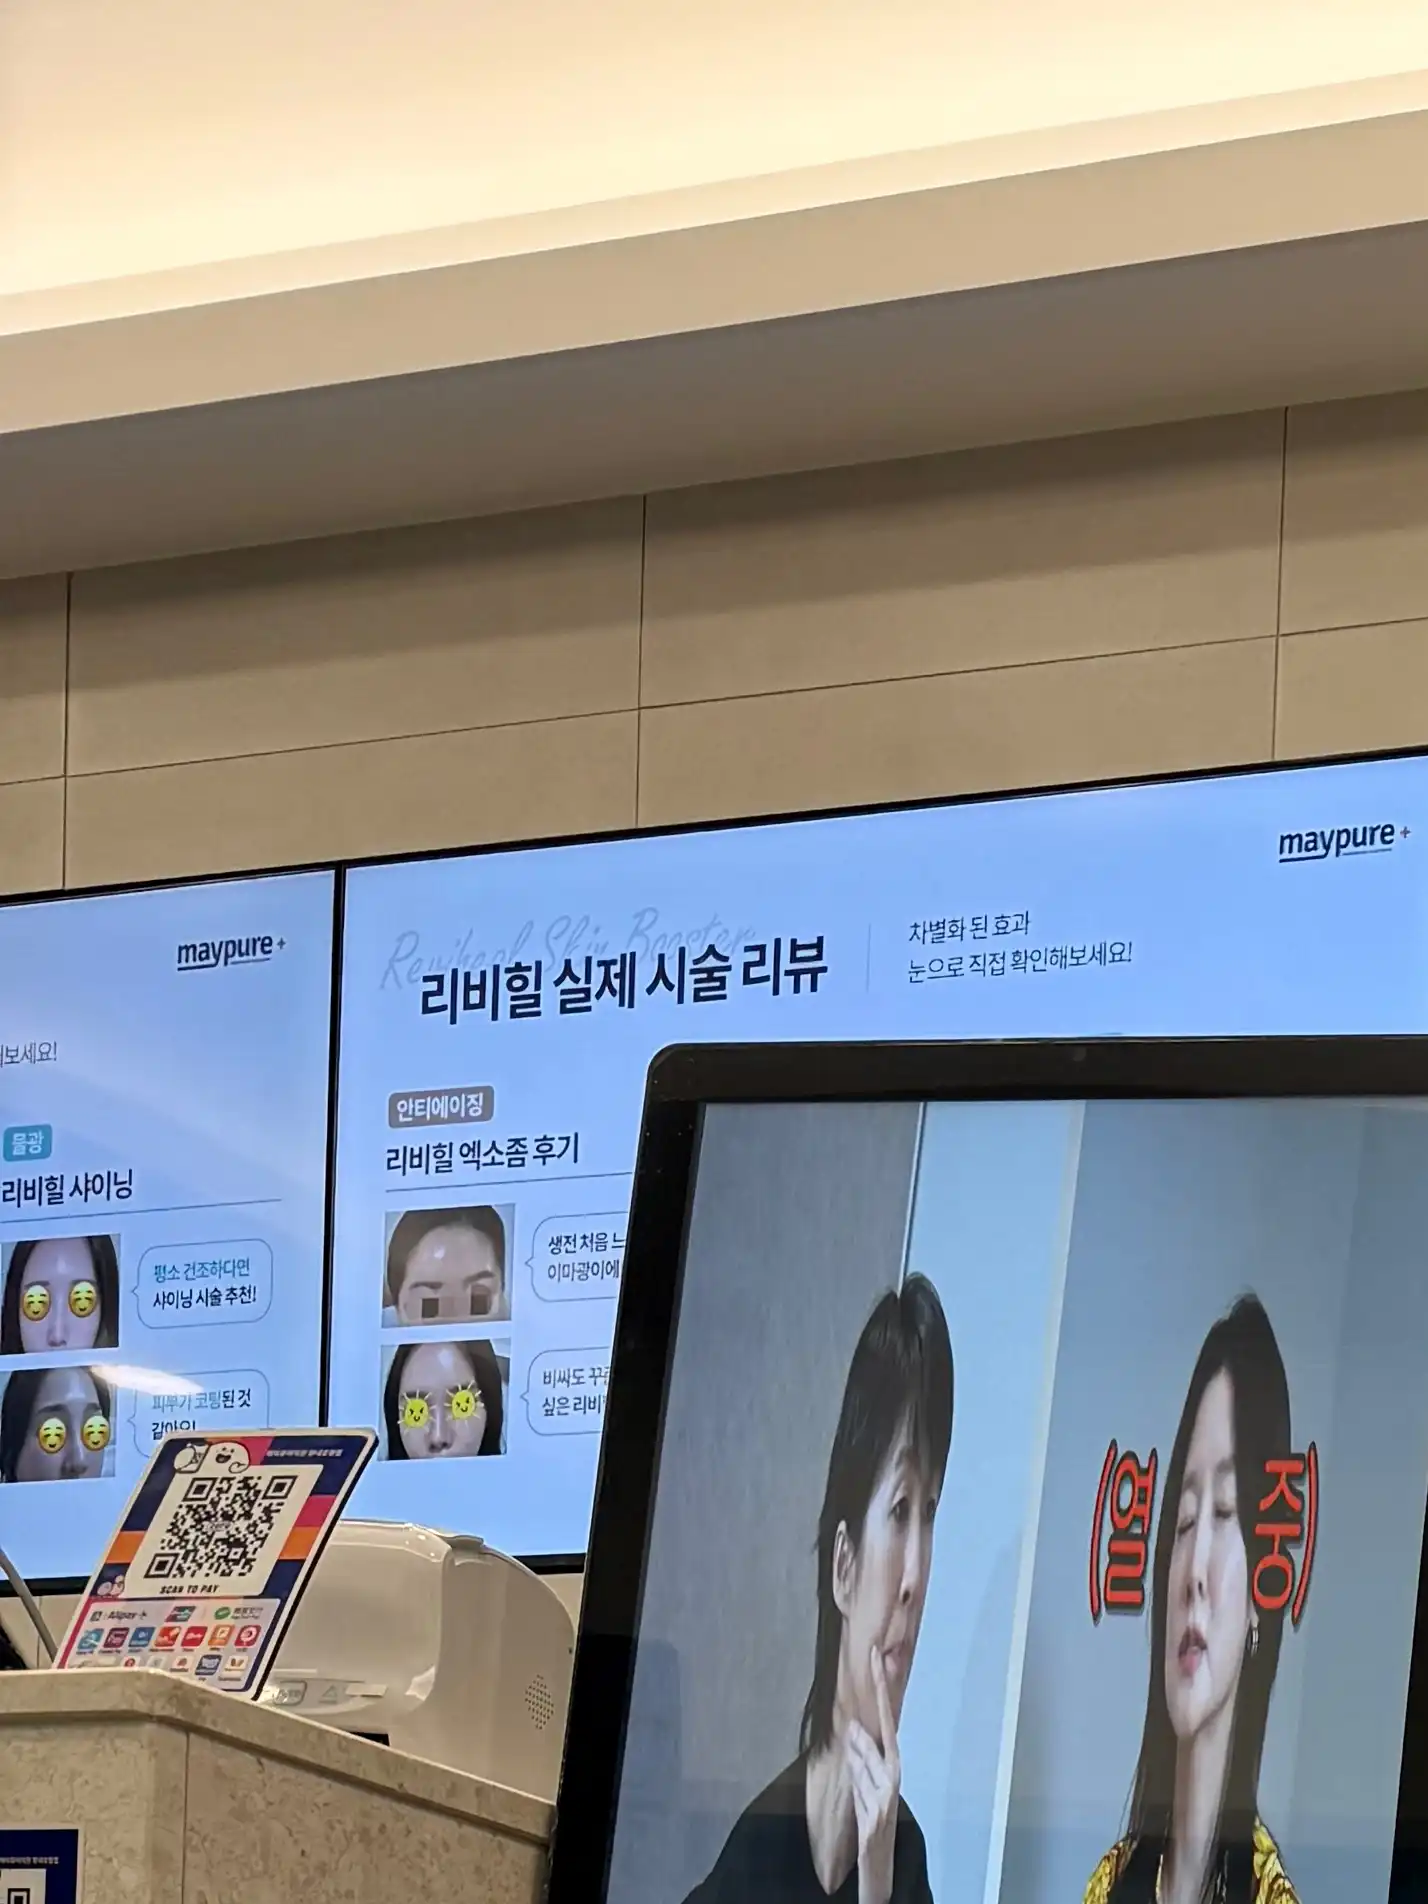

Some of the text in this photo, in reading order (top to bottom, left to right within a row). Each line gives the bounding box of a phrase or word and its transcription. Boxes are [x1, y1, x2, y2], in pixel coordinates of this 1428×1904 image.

[908, 911, 1031, 946] 차별화 된 효과
[908, 941, 1133, 984] 눈으로 직접 확인해보세요!
[420, 936, 828, 1025] 리비힐 실제 시술 리뷰
[396, 1092, 484, 1121] 안티에이징
[386, 1132, 579, 1175] 리비힐 엑소좀 후기
[2, 1169, 133, 1208] 리비힐 샤이닝
[548, 1233, 577, 1255] 생전
[580, 1232, 608, 1253] 처음
[154, 1257, 250, 1283] 평소 건조하다면
[547, 1259, 620, 1284] 이마광이에
[153, 1285, 256, 1310] 샤이닝 시술 추천!
[543, 1367, 586, 1389] 비싸도
[195, 1388, 235, 1409] 코팅된
[238, 1388, 251, 1408] 것
[542, 1393, 607, 1417] 싶은 리비
[160, 1585, 220, 1594] SCAN TO PAY
